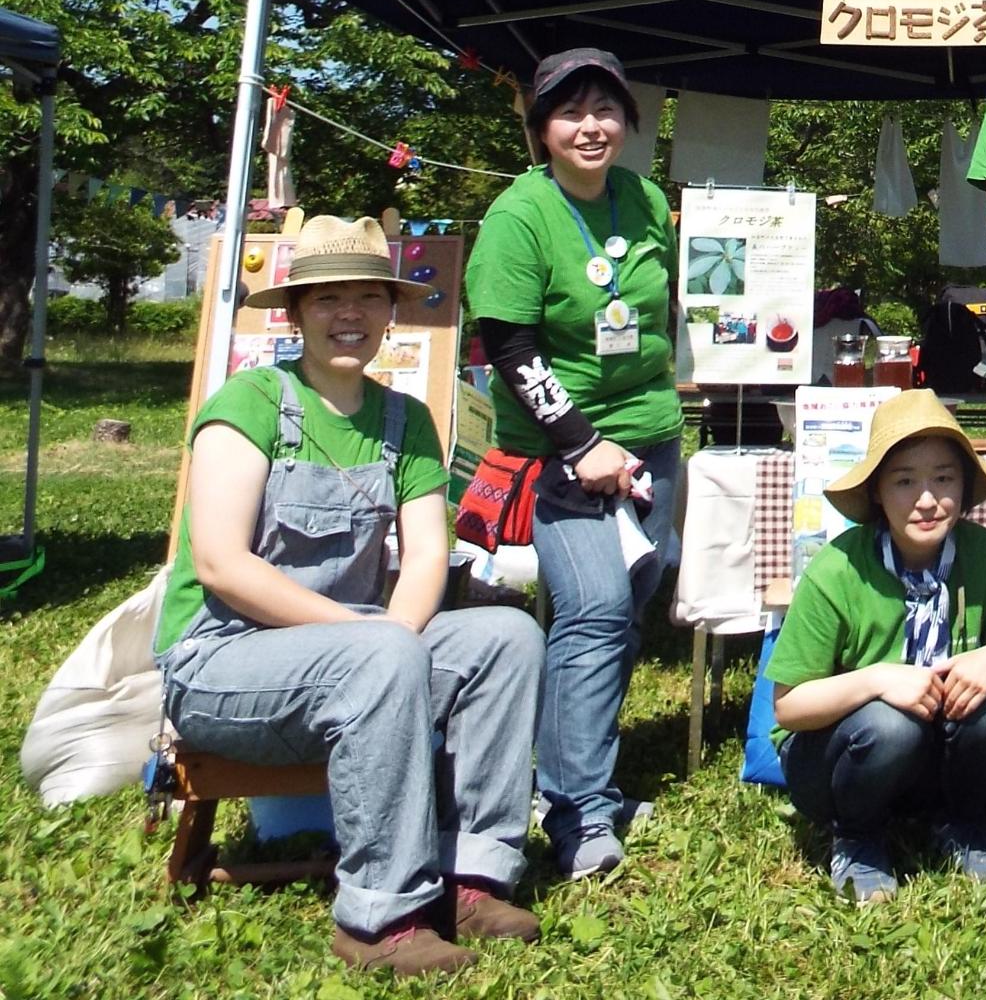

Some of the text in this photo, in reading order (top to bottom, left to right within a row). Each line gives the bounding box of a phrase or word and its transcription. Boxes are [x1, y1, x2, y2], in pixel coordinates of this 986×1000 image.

[718, 214, 784, 228] クロモジ茶
